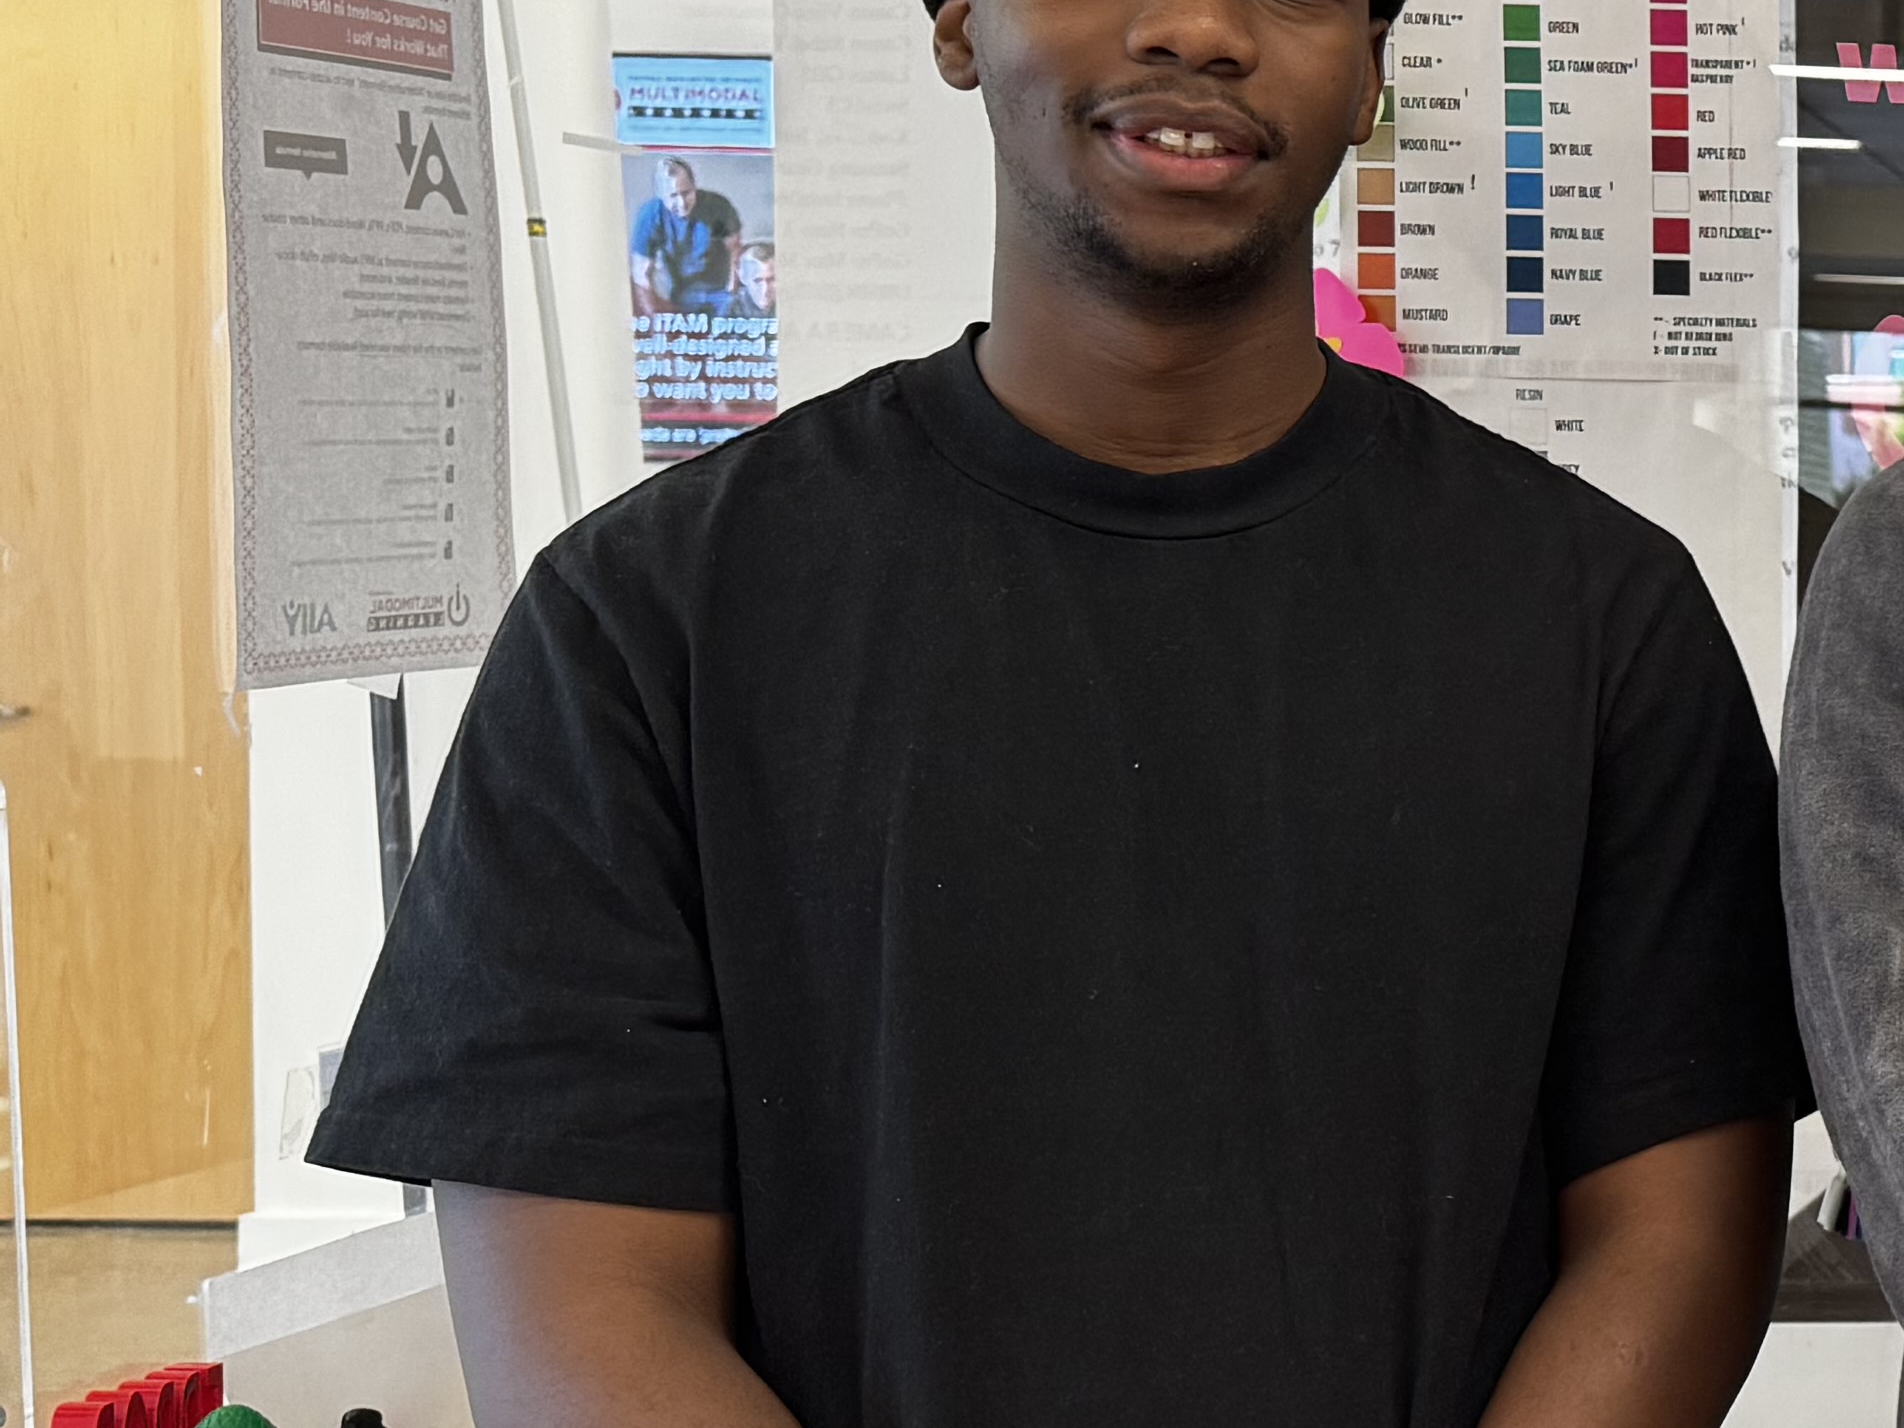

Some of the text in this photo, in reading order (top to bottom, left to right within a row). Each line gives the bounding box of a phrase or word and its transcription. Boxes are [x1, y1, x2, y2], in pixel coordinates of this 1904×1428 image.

[1404, 12, 1430, 25] GLOW
[1548, 22, 1580, 34] GREEN
[1695, 23, 1738, 36] HOT PINK
[1402, 56, 1432, 68] CLEAR
[1548, 59, 1566, 73] SEA
[1568, 60, 1595, 73] FOAM
[629, 86, 763, 103] MULTIMODAL
[1400, 97, 1461, 110] OLIVE GREEN
[1549, 102, 1571, 115] TEAL
[1696, 111, 1715, 123] RED
[1399, 139, 1428, 151] WOOD
[1550, 143, 1593, 156] SKY BLUE
[1697, 147, 1746, 160] APPLE RED
[1399, 181, 1465, 195] LIGHT BROWN
[1550, 185, 1603, 198] LIGHT BLUE
[1698, 190, 1727, 203] WHITE
[1400, 223, 1436, 236] BROWN
[1550, 228, 1605, 241] ROYAL BLUE
[1699, 226, 1718, 239] RED
[1400, 268, 1439, 280] ORANGE
[1551, 269, 1603, 281] NAVY BLUE
[1699, 271, 1724, 282] BLACK
[1402, 309, 1448, 321] MUSTARD
[1550, 314, 1581, 326] GRAPE
[653, 312, 708, 333] ITAM
[674, 356, 702, 381] by
[651, 382, 707, 400] want
[709, 382, 750, 404] you
[1516, 389, 1543, 401] RESIN
[1555, 420, 1584, 432] WHITE
